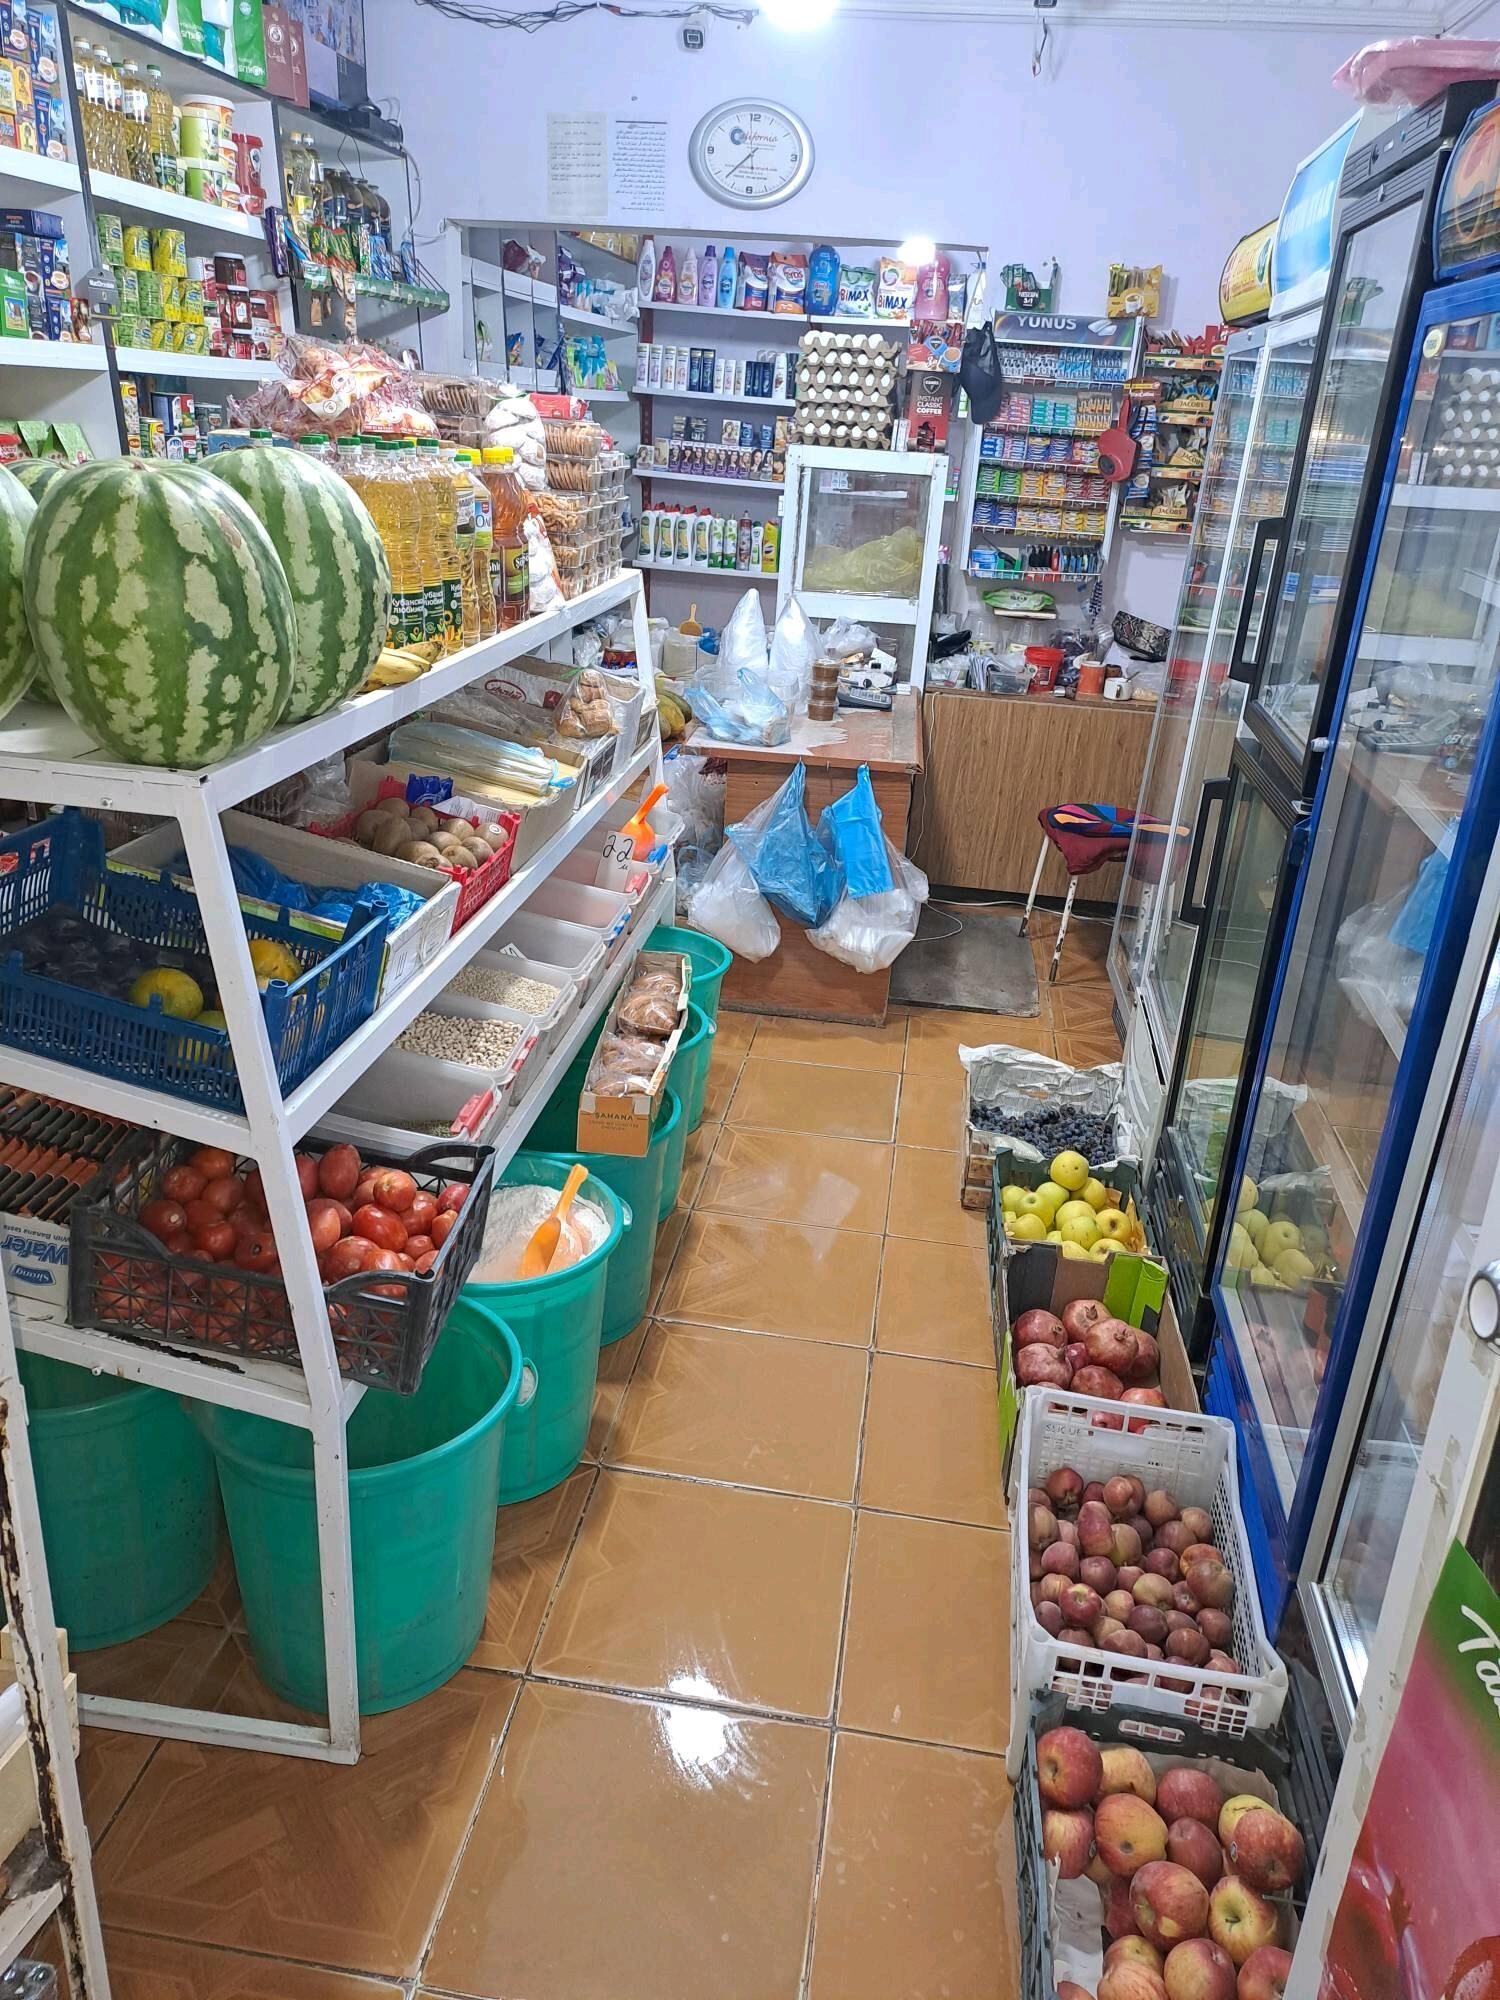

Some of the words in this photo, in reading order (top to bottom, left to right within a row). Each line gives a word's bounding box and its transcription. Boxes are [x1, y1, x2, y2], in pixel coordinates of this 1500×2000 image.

[749, 113, 761, 121] 12
[707, 146, 715, 155] 9
[790, 153, 798, 162] 3
[745, 185, 753, 195] 6
[1017, 315, 1077, 331] YUNUS
[916, 407, 943, 415] COFFEE
[602, 834, 634, 863] 22
[595, 1112, 633, 1121] SAHANA
[0, 1233, 70, 1265] Wafer
